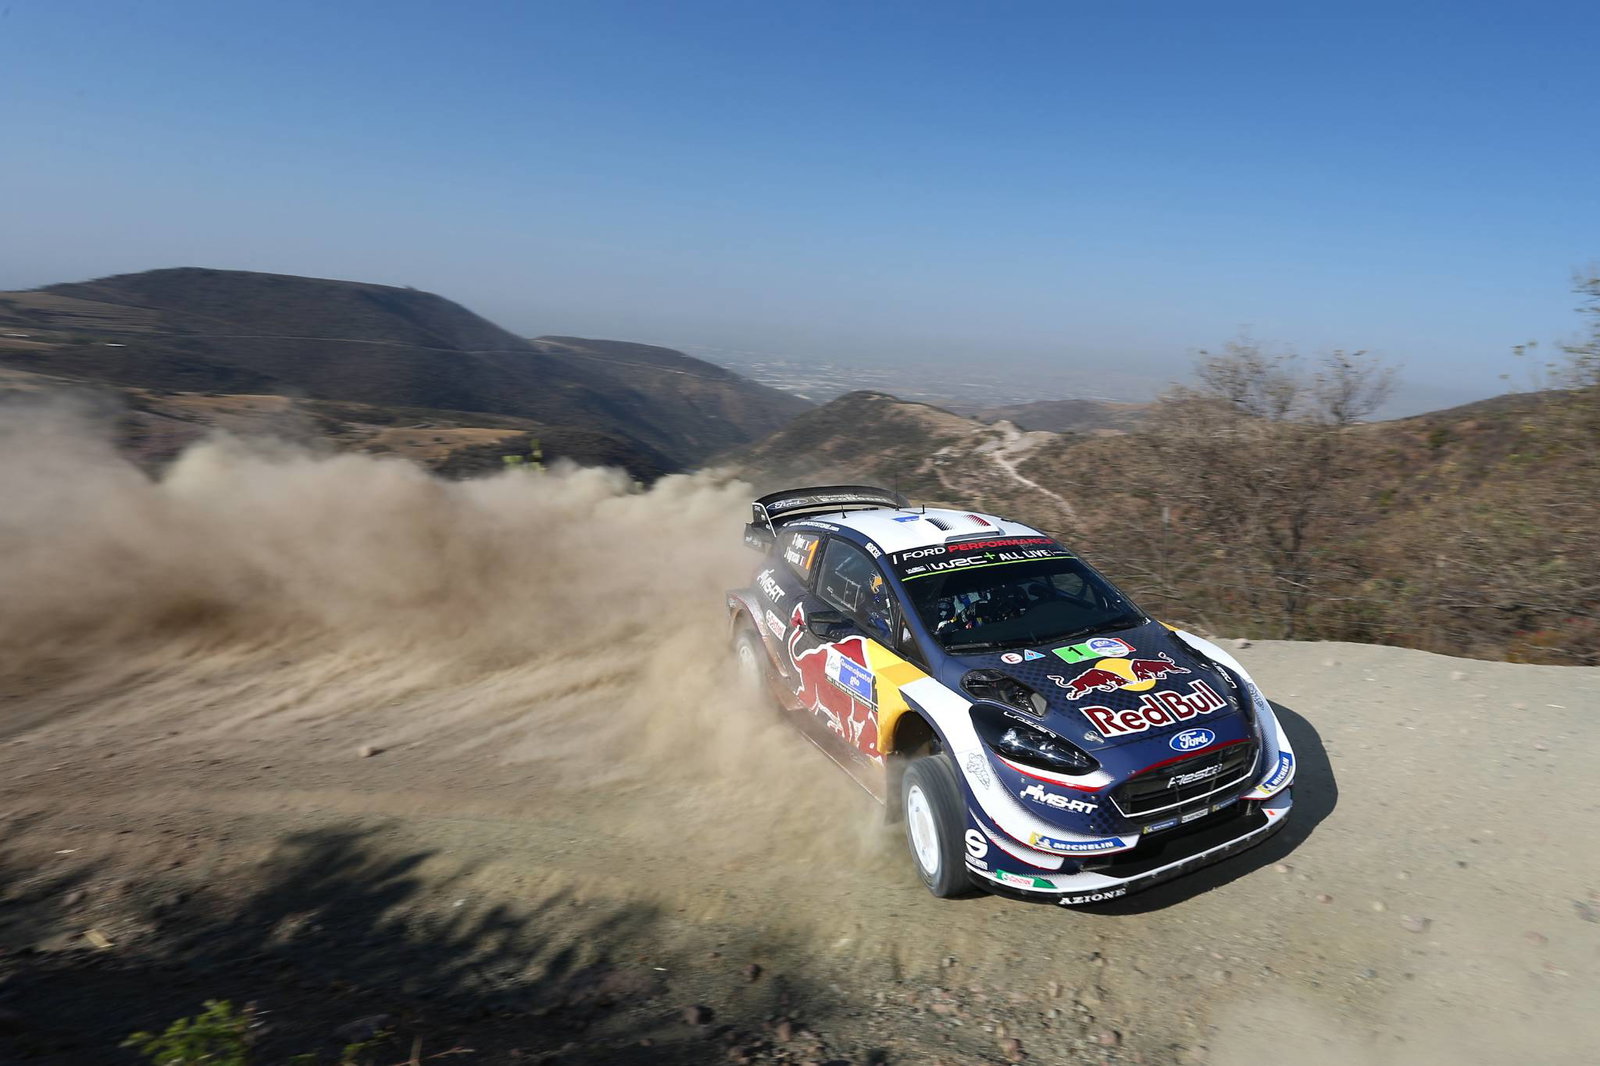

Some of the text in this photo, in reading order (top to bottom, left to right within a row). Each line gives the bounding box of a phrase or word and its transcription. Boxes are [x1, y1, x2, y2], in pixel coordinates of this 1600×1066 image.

[806, 540, 819, 570] 1
[902, 538, 1055, 561] FORD PERFORMANCE
[999, 550, 1023, 562] ALL
[1023, 549, 1051, 559] LIVE
[1005, 655, 1019, 663] E
[1067, 646, 1084, 656] 1
[1082, 696, 1173, 735] Red
[1157, 680, 1225, 719] Bull
[1178, 731, 1209, 749] Ford
[1272, 756, 1290, 786] MICHELIN
[1053, 840, 1114, 851] MICHELIN
[1058, 887, 1126, 905] AZIONE
